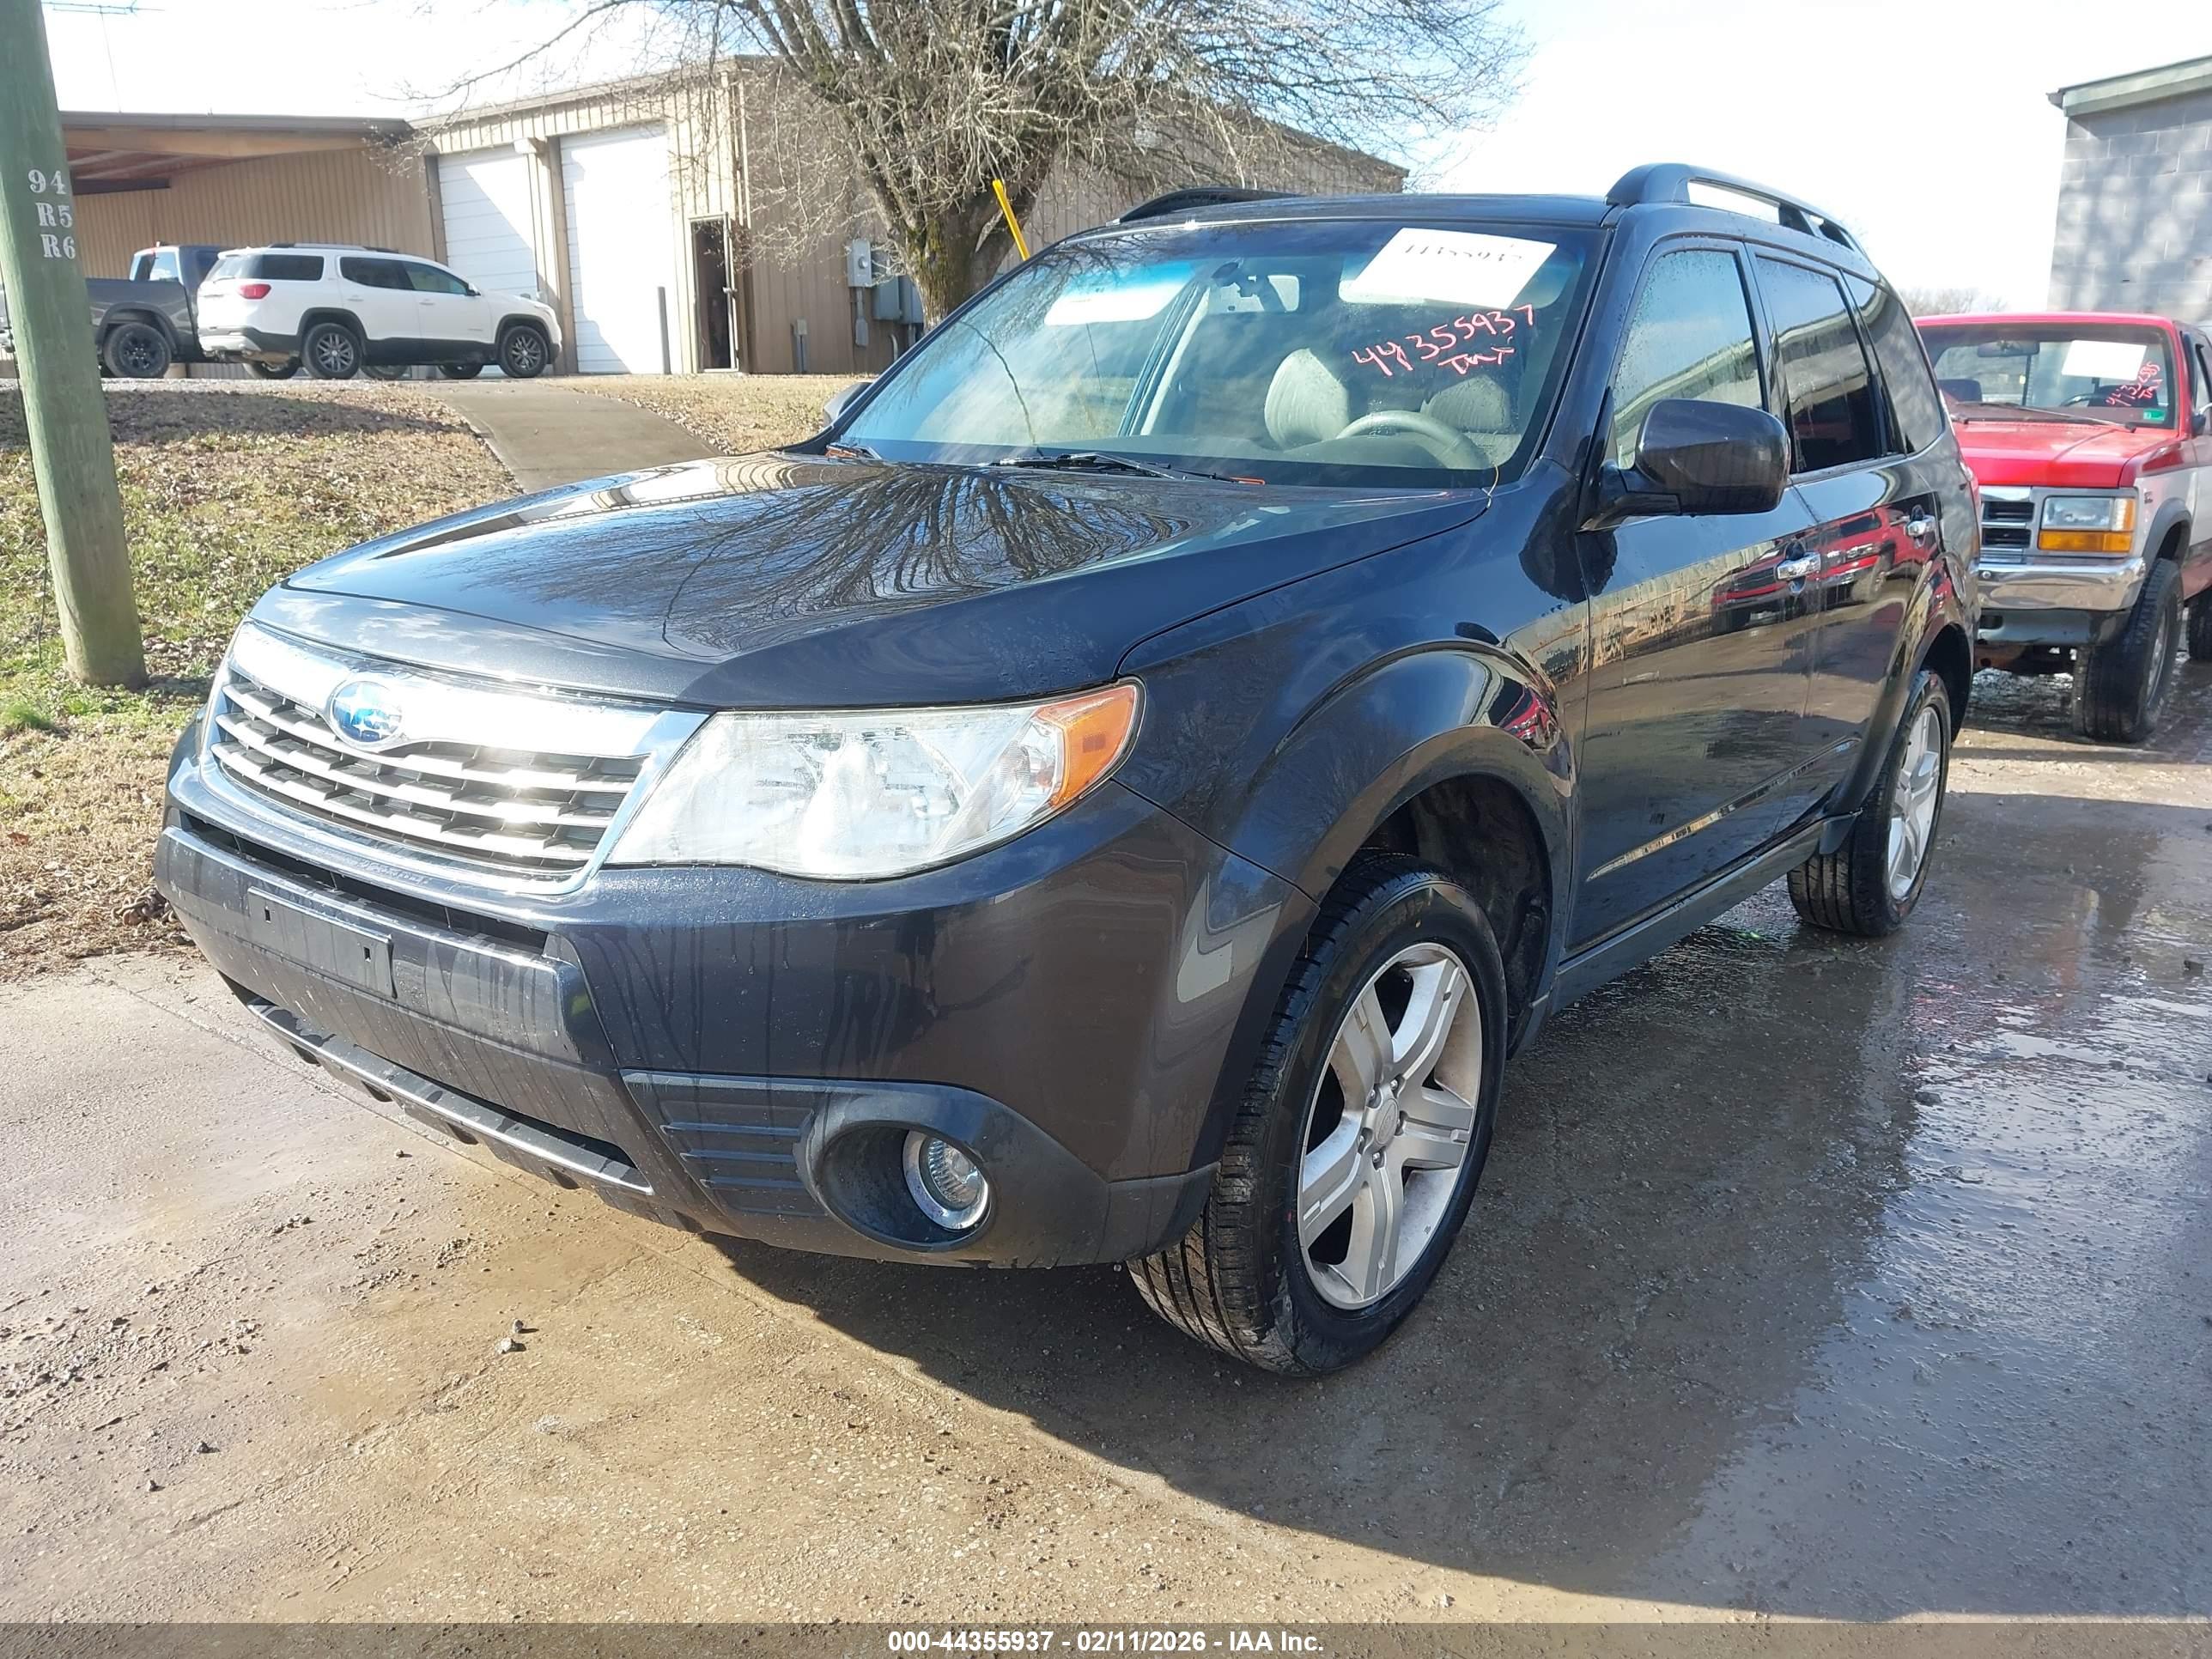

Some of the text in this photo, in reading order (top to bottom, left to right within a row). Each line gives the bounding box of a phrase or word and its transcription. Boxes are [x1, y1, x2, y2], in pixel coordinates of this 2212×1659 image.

[27, 169, 66, 195] 94
[35, 202, 73, 228] R5
[40, 234, 76, 259] R6
[1352, 304, 1534, 376] 44355937
